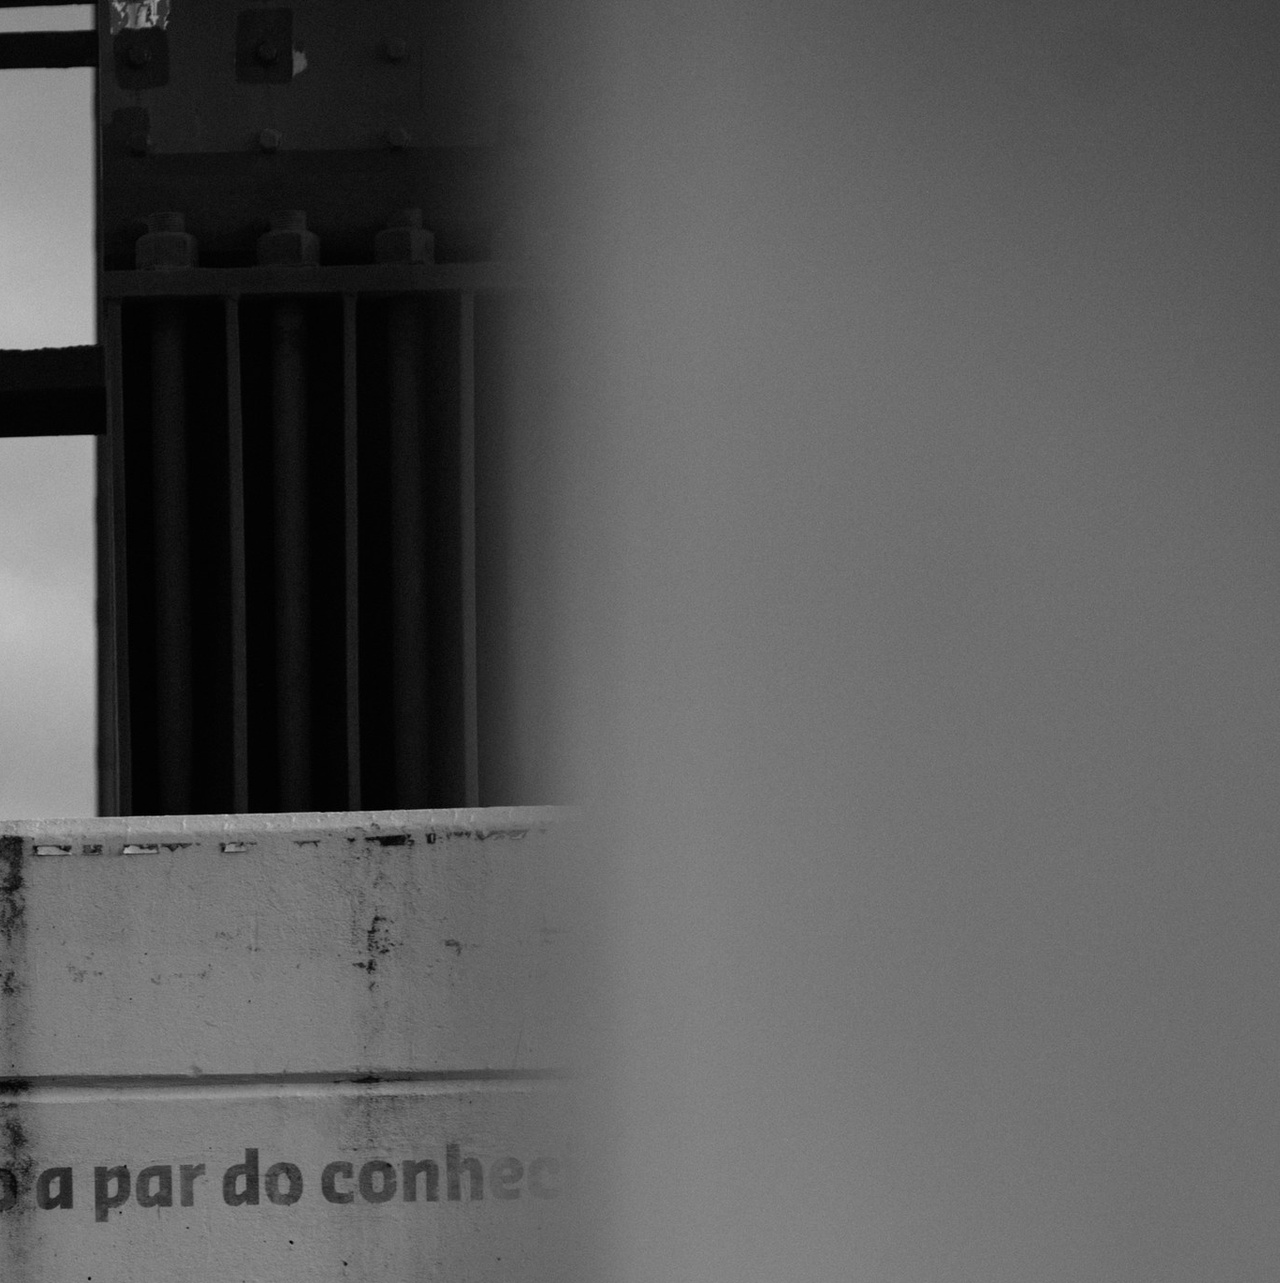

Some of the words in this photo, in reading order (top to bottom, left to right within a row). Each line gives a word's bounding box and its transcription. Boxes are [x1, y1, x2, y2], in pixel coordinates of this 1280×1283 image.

[36, 1166, 73, 1211] a
[93, 1164, 206, 1223] par
[222, 1148, 304, 1207] do
